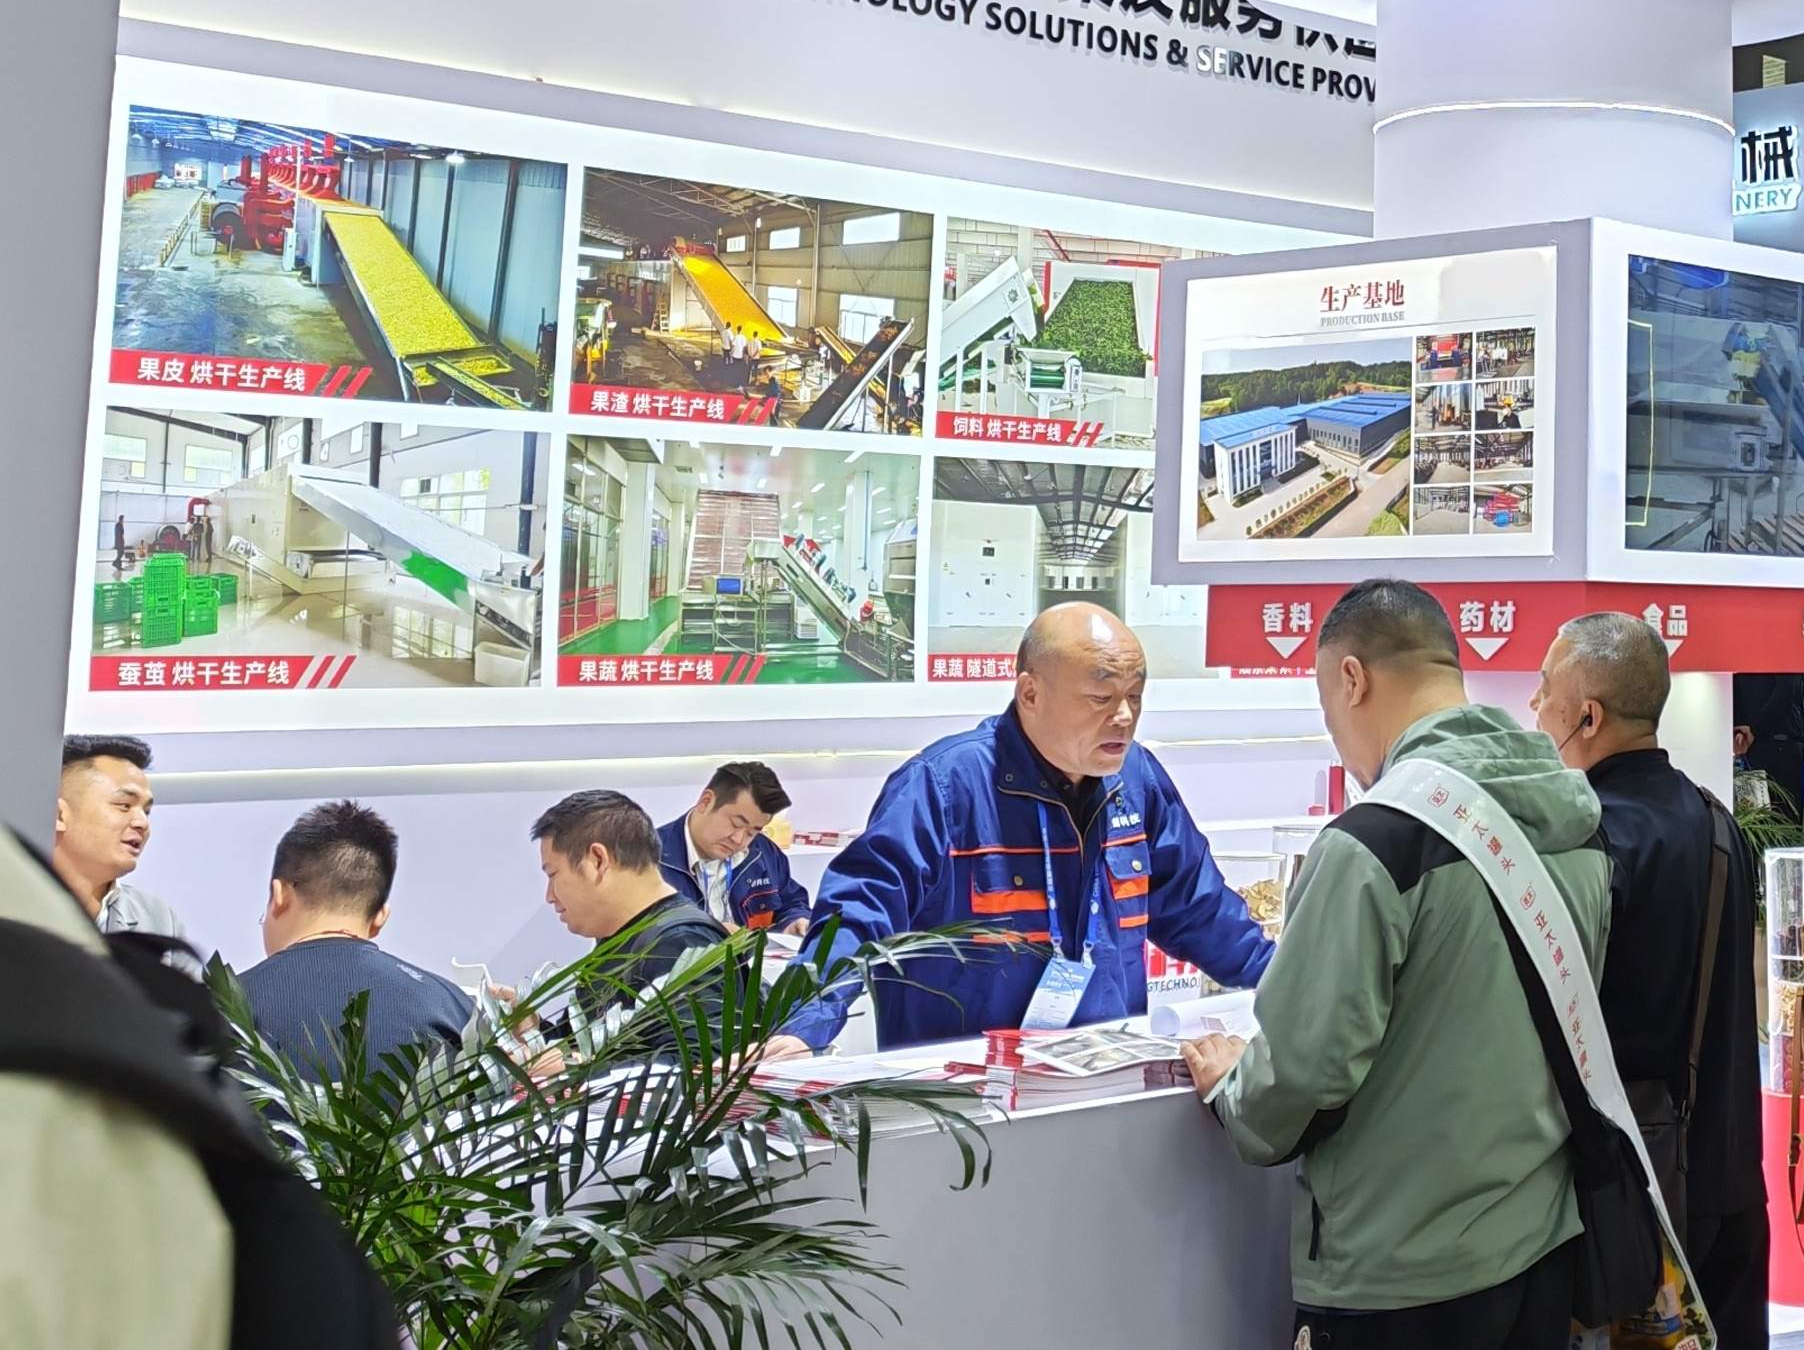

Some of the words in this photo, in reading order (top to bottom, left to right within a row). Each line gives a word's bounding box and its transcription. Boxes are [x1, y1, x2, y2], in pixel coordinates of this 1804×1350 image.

[984, 1, 1158, 62] SOLUTIONS
[1166, 37, 1188, 68] &
[1197, 44, 1305, 90] SERVICE
[1319, 279, 1405, 313] 生产基地
[1321, 313, 1380, 328] PRODUCTION
[1381, 310, 1406, 323] BASE
[137, 357, 186, 384] 果皮
[189, 360, 307, 393] 烘干生产线
[592, 389, 629, 415] 果渣
[633, 393, 725, 421] 烘干生产线
[953, 415, 984, 438] 饲料
[987, 417, 1063, 444] 烘干生产线
[1261, 601, 1314, 634] 香料
[1459, 599, 1517, 634] 药材
[1641, 601, 1689, 637] 食品
[118, 662, 166, 686] 蚕茧
[171, 660, 290, 686] 烘干生产线
[579, 659, 617, 683] 果蔬
[621, 659, 715, 683] 烘干生产线
[932, 658, 964, 678] 果蔬
[966, 658, 1017, 678] 隧道式
